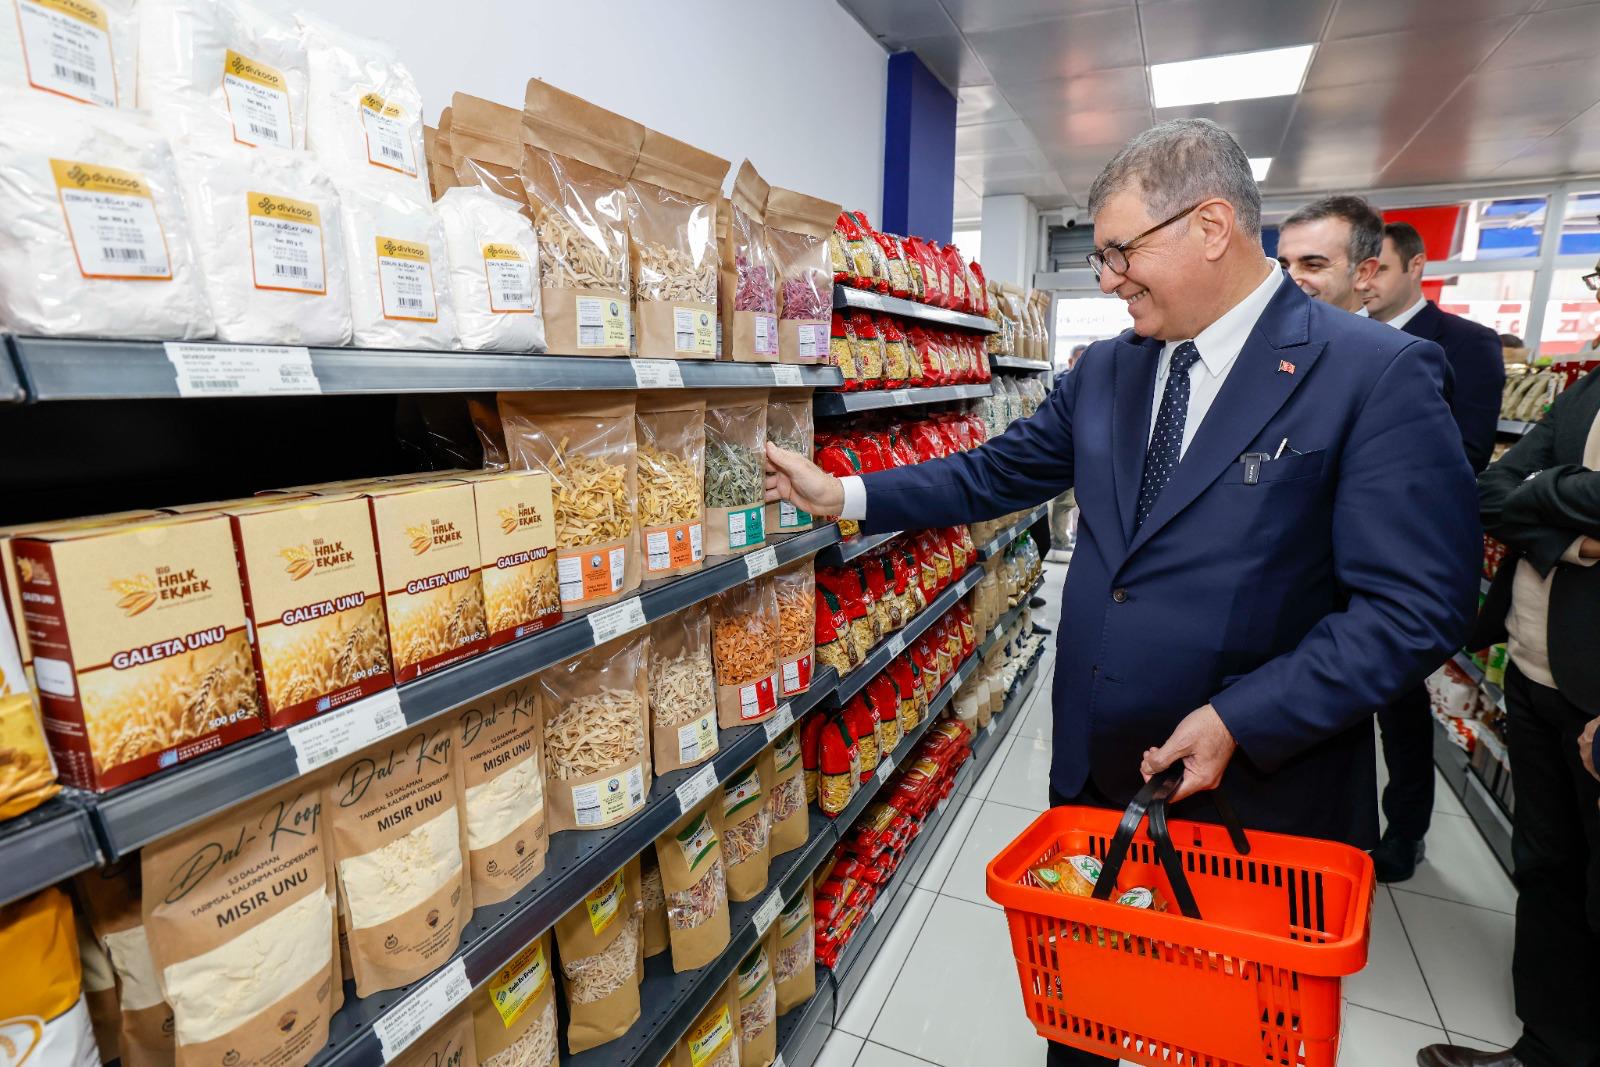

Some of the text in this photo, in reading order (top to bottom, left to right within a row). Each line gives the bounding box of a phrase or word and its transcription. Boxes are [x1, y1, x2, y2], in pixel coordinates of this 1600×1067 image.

[92, 172, 140, 189] divkoop
[277, 203, 313, 218] divkoop
[396, 245, 425, 257] divkoop
[518, 506, 536, 518] HALK
[519, 514, 542, 527] EKMEK
[433, 522, 455, 536] HALK
[434, 530, 463, 545] EKMEK
[314, 541, 345, 557] HALK
[496, 547, 548, 569] GALETA UNU
[316, 551, 355, 568] EKMEK
[157, 568, 198, 587] HALK
[407, 567, 470, 595] GALETA UNU
[160, 580, 212, 600] EKMEK
[282, 593, 365, 625] GALETA UNU
[833, 612, 846, 625] TAT
[112, 627, 225, 670] GALETA UNU
[483, 739, 532, 773] MISIR UNU
[394, 777, 423, 795] DALAMAN
[377, 790, 443, 833] MISIR UNU
[240, 855, 280, 881] DALAMAN
[191, 895, 232, 917] TARIMSAL
[232, 871, 273, 898] KALKINMA
[216, 868, 309, 928] MISIR UNU
